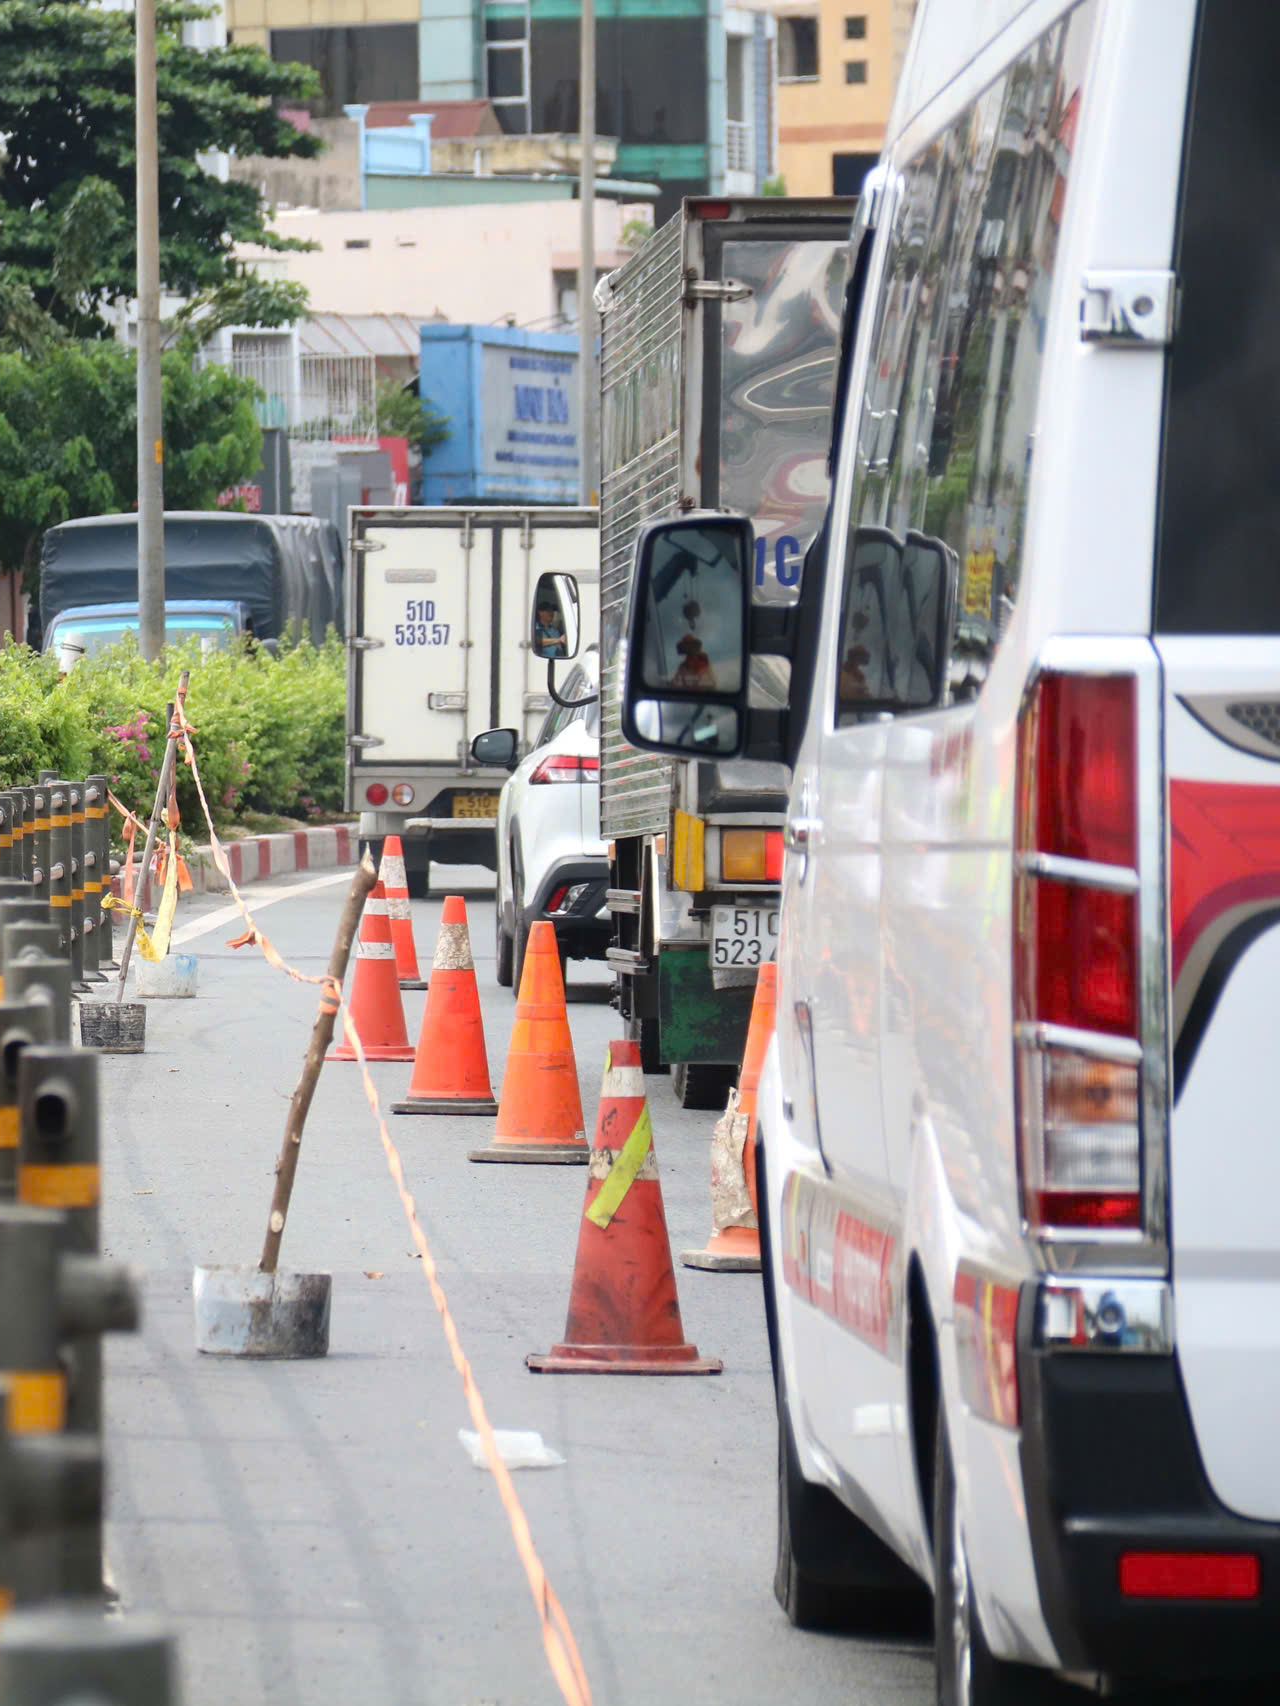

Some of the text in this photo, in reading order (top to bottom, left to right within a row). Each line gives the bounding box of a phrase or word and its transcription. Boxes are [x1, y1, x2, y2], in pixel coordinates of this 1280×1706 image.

[754, 535, 801, 587] 1C
[406, 600, 435, 621] 51D
[395, 623, 450, 646] 533.57
